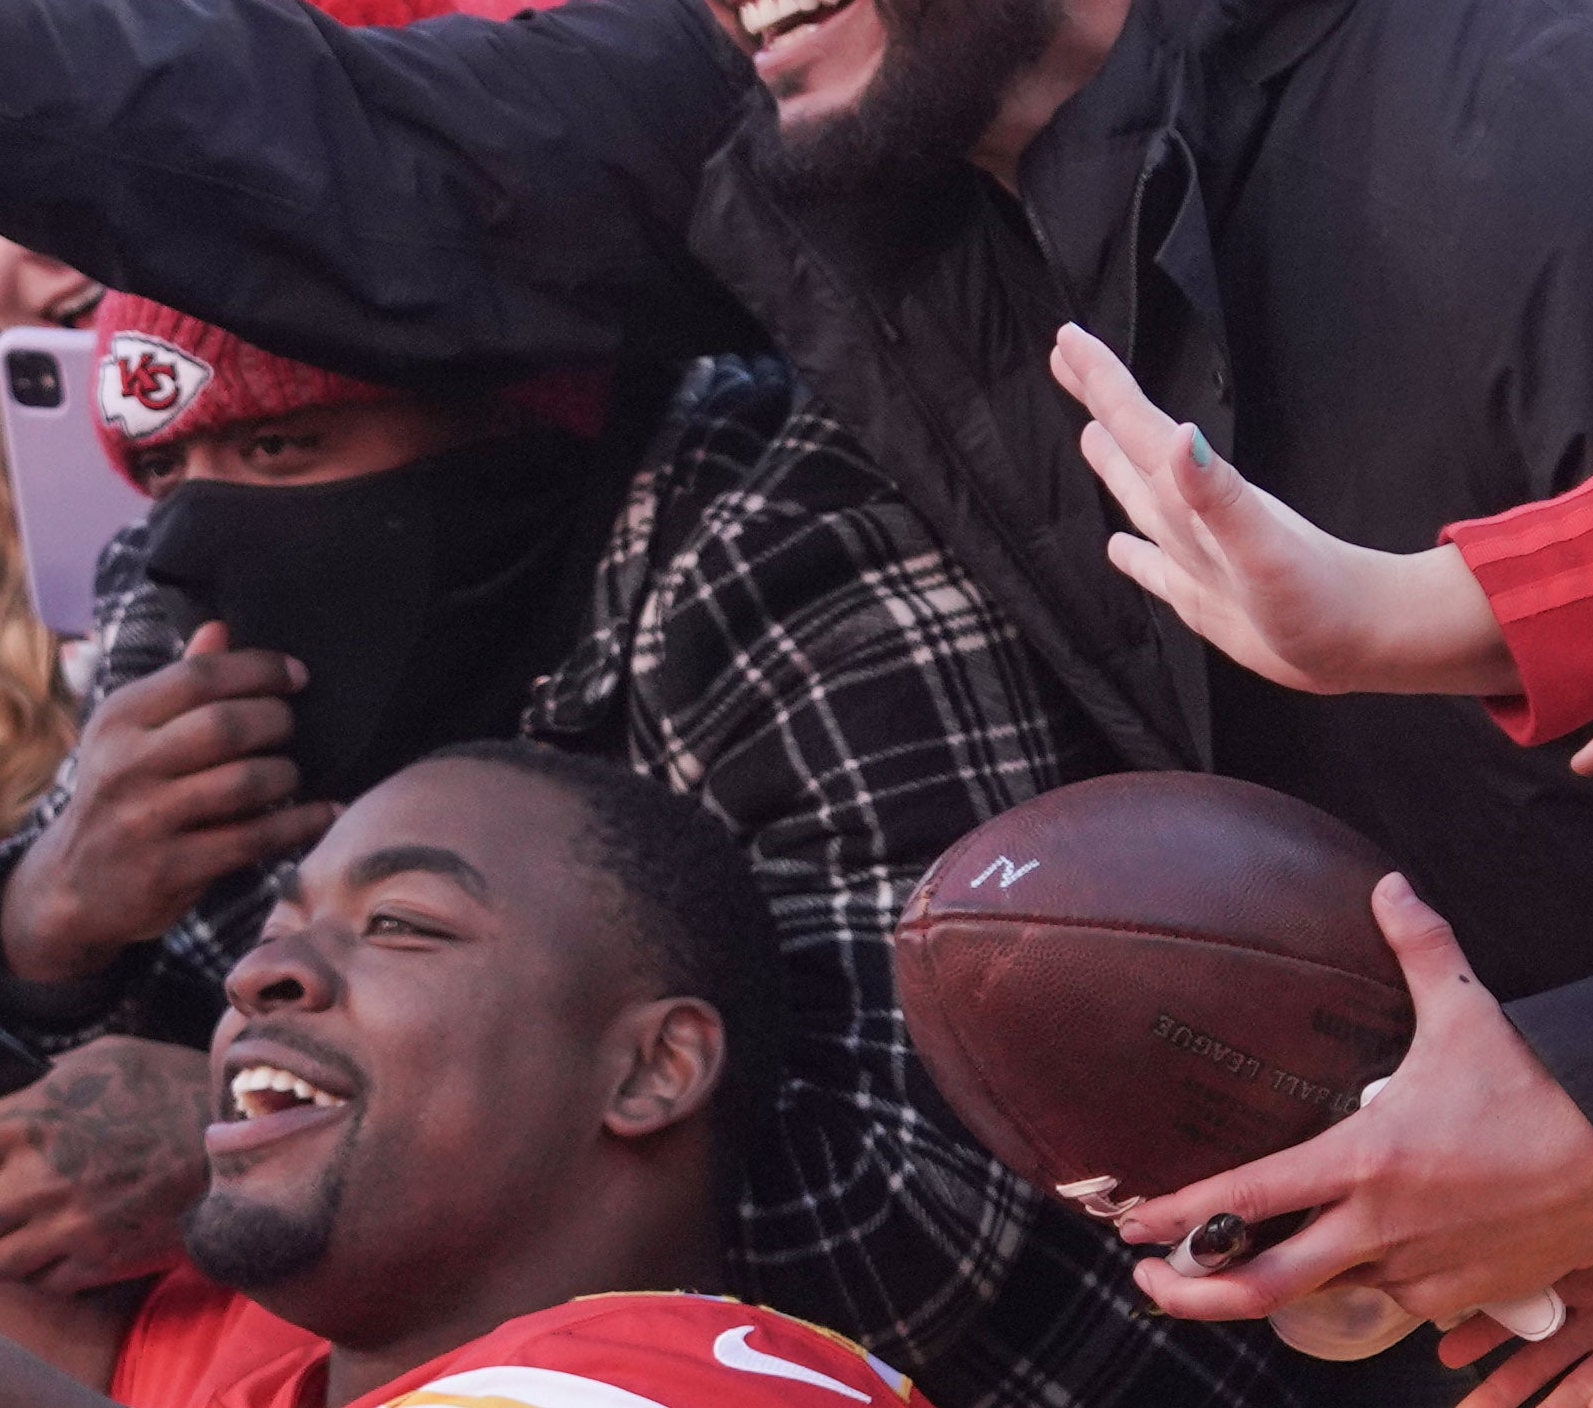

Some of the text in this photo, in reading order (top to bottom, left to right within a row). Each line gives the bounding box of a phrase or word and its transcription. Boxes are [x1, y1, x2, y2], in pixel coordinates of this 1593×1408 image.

[117, 353, 180, 410] KC
[1149, 1013, 1263, 1085] LEAGUE
[1268, 1067, 1362, 1115] OTBALL
